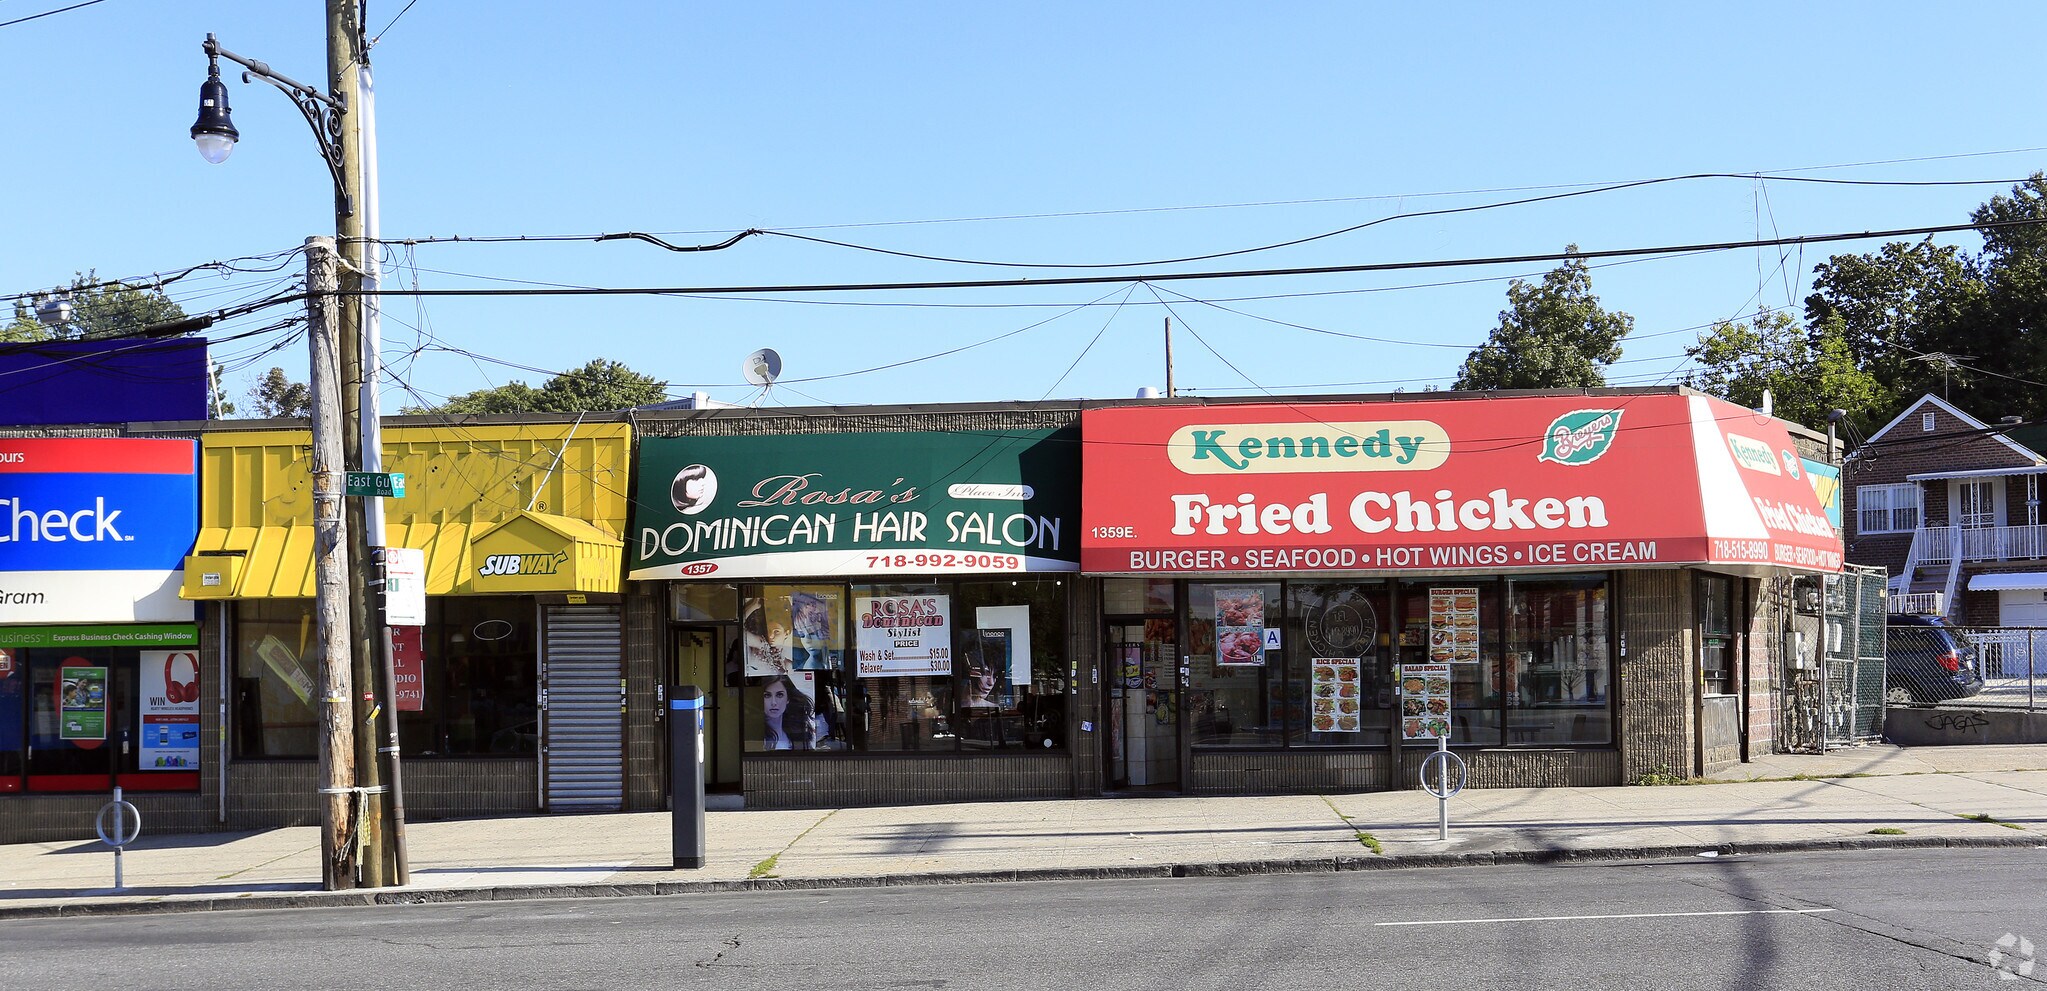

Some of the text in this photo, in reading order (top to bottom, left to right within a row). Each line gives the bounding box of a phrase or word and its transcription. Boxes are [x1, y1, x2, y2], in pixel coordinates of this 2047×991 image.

[1554, 414, 1612, 459] Breyers
[1191, 429, 1426, 470] Kennedy
[1729, 438, 1777, 470] Kennedy
[347, 474, 371, 487] East
[736, 470, 921, 507] Rosa's
[376, 488, 392, 496] Road
[951, 484, 995, 497] Place
[1170, 489, 1609, 536] Fried Chicken
[1753, 496, 1835, 539] Fried Chicken
[640, 510, 1061, 562] DOMINICAN HAIR SALON
[1091, 526, 1138, 539] 1359E.
[1130, 541, 1657, 569] BURGER SEAFOOD HOT WINGS ICE CREAM
[1714, 540, 1769, 560] 718-515-8990
[1774, 543, 1793, 562] BURGER
[1795, 546, 1816, 566] SEAFOOD
[1818, 549, 1828, 567] HOT
[478, 551, 568, 578] SUBWAY
[687, 564, 713, 575] 1357
[866, 554, 1020, 570] 718-992-9059
[870, 598, 937, 617] ROSA'S
[862, 612, 944, 629] Dominican
[53, 634, 80, 642] Express
[81, 633, 111, 641] Business
[134, 633, 163, 641] Cashing
[164, 632, 193, 640] Window
[886, 628, 922, 639] Stylist
[1267, 631, 1278, 644] A
[860, 648, 949, 661] Wash & Set $15.00
[860, 660, 950, 674] Relaxer $30.00
[394, 674, 417, 683] DIO
[149, 696, 166, 706] WIN
